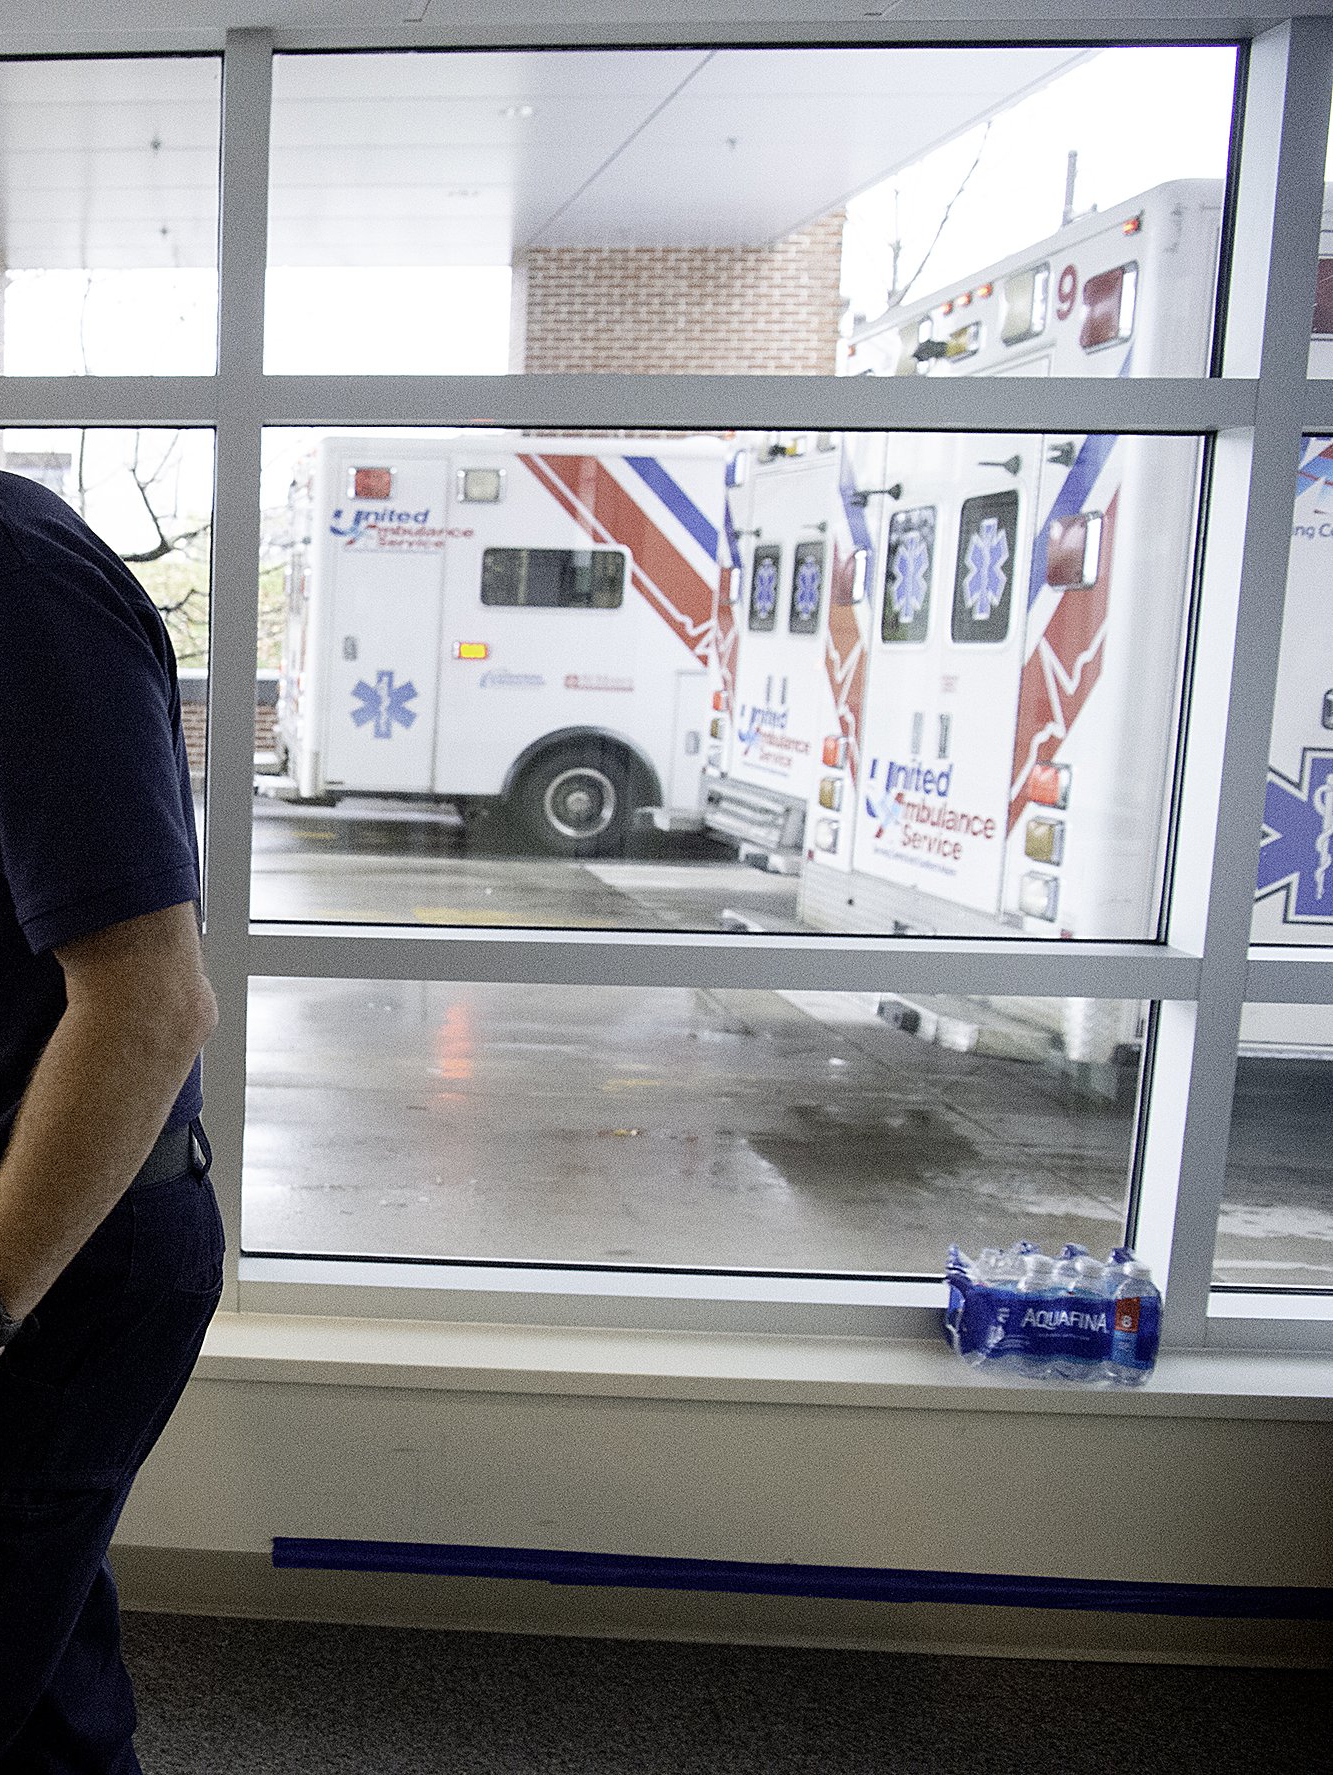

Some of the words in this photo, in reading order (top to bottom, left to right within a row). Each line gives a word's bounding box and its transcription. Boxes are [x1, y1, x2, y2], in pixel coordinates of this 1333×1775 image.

[1056, 264, 1077, 320] 9
[330, 508, 429, 537] United
[902, 823, 963, 860] Service
[1021, 1308, 1109, 1334] AQUAFINA
